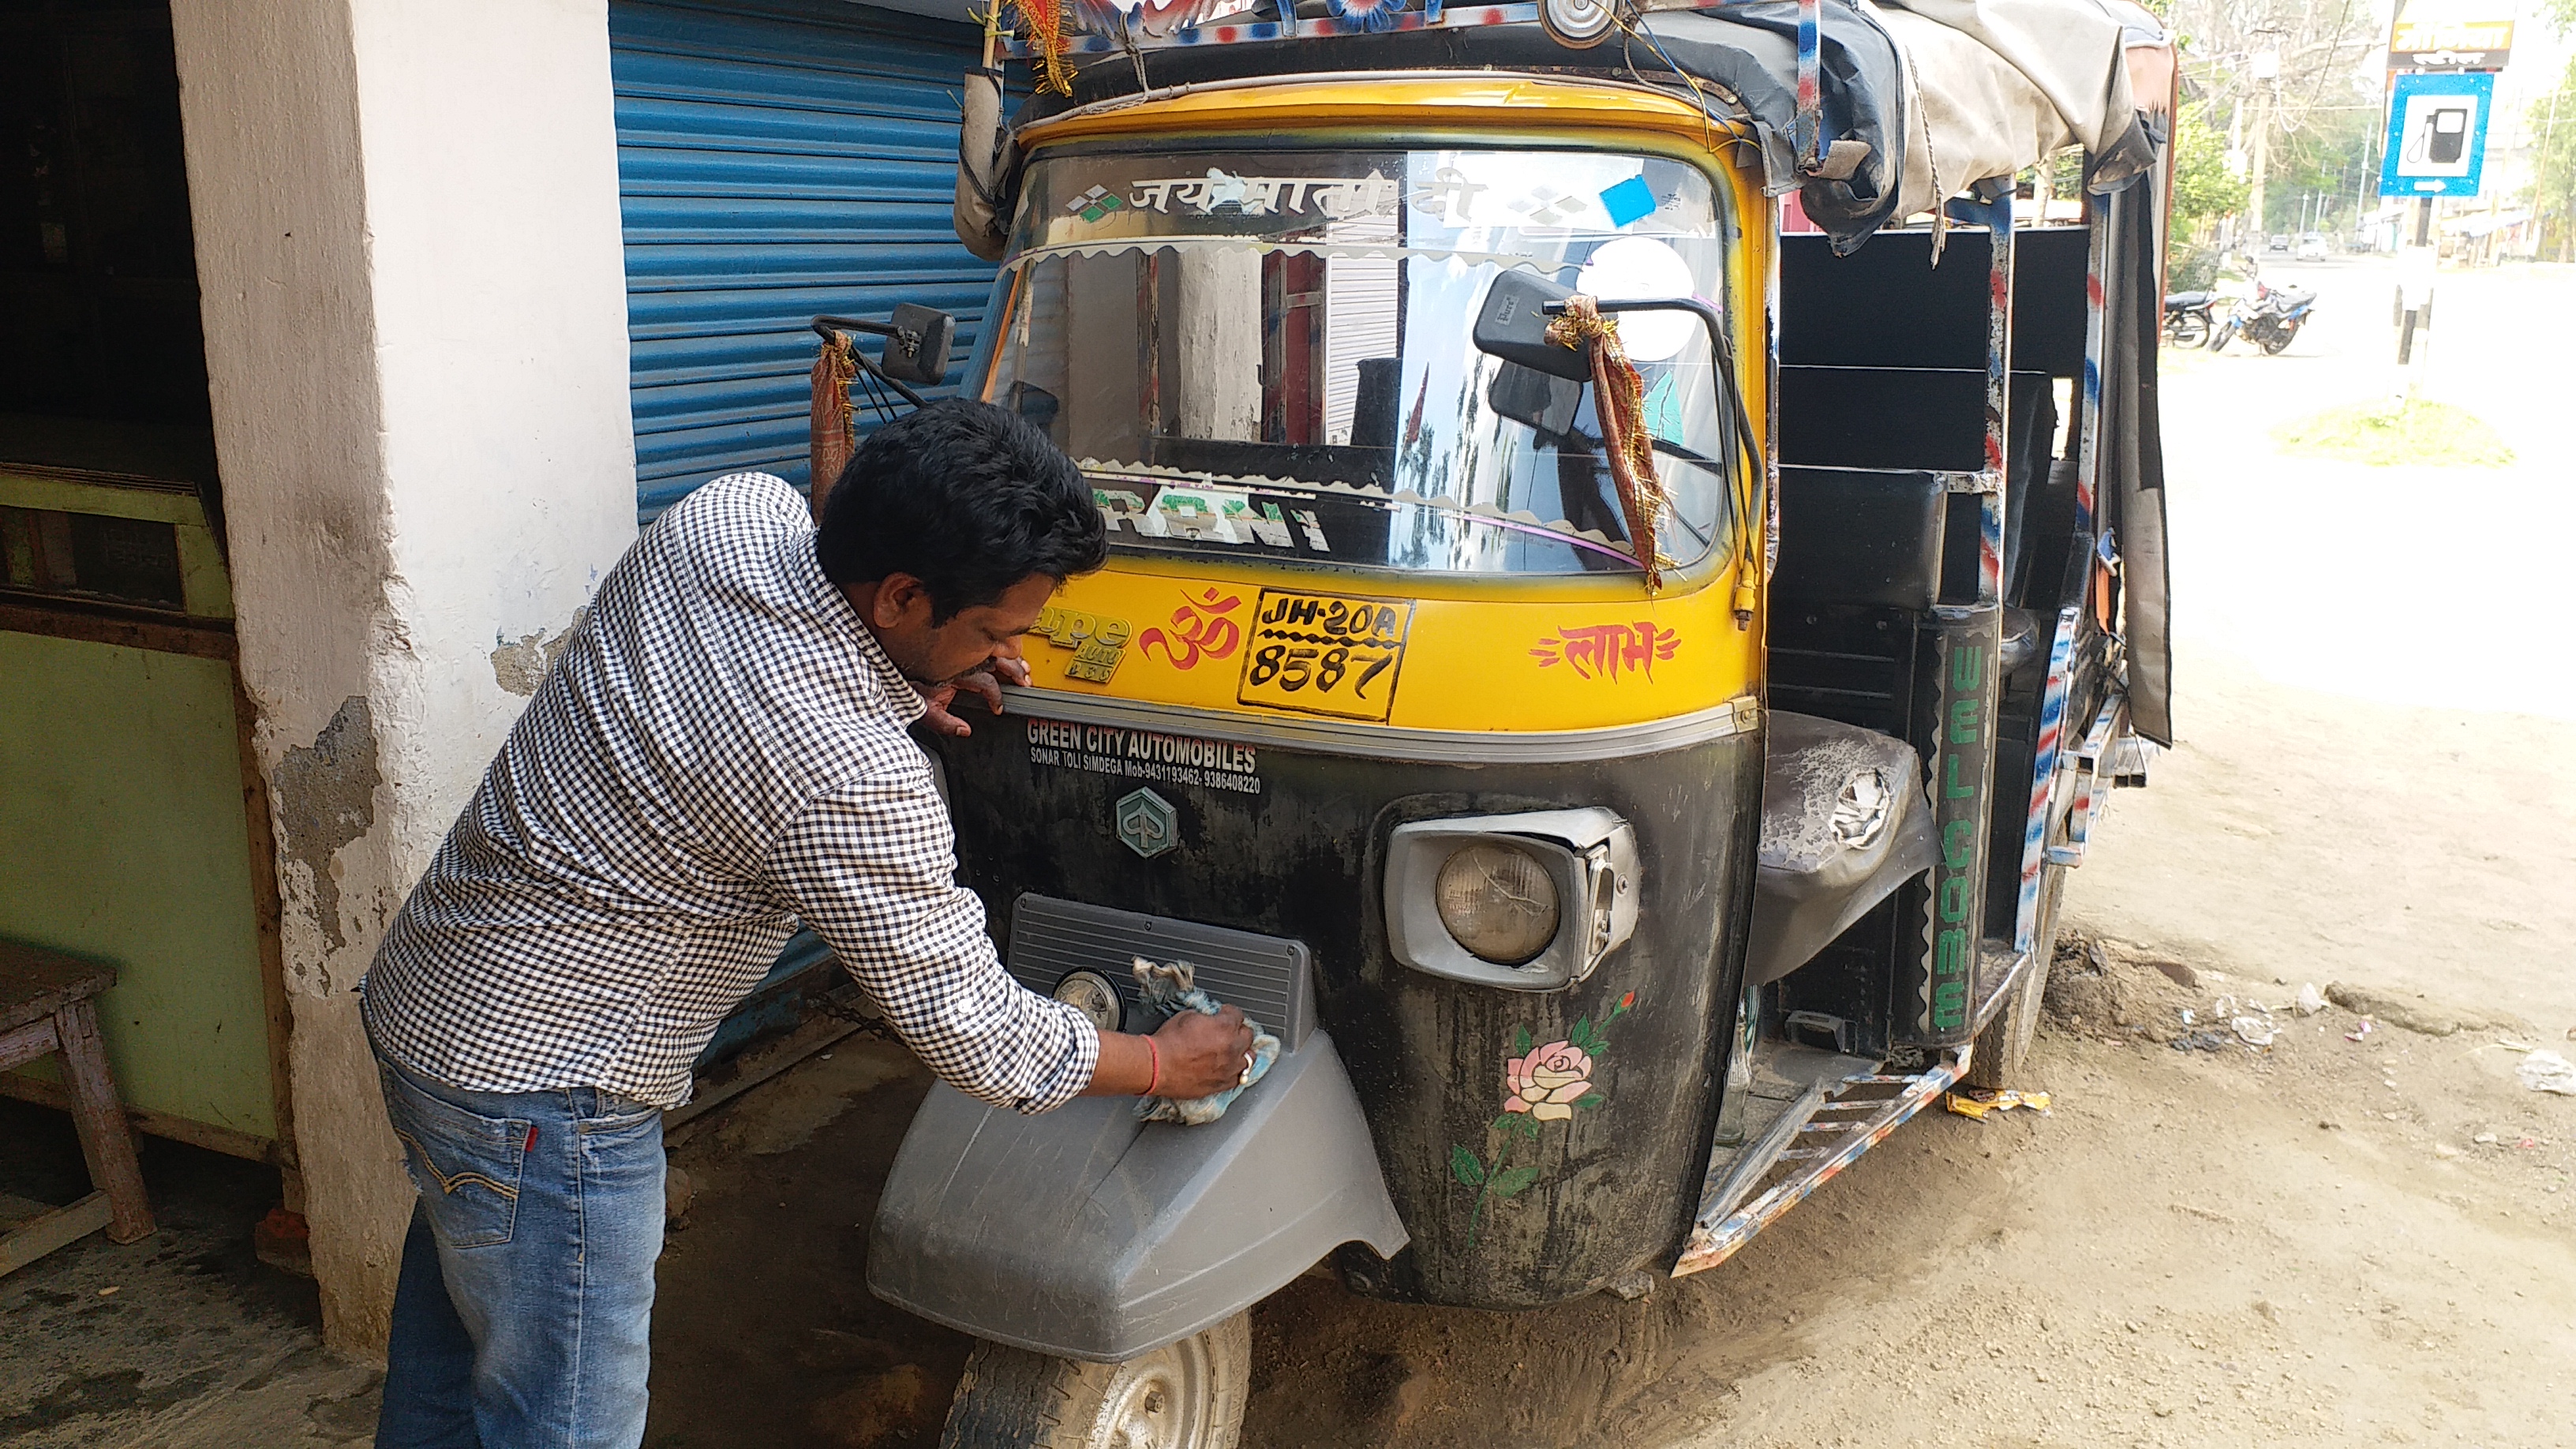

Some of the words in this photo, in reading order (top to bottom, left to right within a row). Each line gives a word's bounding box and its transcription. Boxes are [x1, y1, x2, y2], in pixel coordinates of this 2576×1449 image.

[1129, 178, 1214, 215] जय
[1410, 167, 1488, 222] दी
[1261, 597, 1396, 637] JH-20A
[1074, 644, 1121, 664] AUTO
[1249, 645, 1394, 700] 8587
[1557, 620, 1659, 685] लाभ
[1027, 717, 1081, 751] GREEN
[1086, 725, 1126, 756] CITY
[1127, 729, 1256, 774] AUTOMOBILES
[1030, 746, 1060, 766] SONAR
[1061, 750, 1081, 769] TOLI
[1083, 753, 1124, 776] SIMDEGA
[1204, 769, 1261, 795] 9386408220
[1934, 646, 1982, 1028] WELCOME
